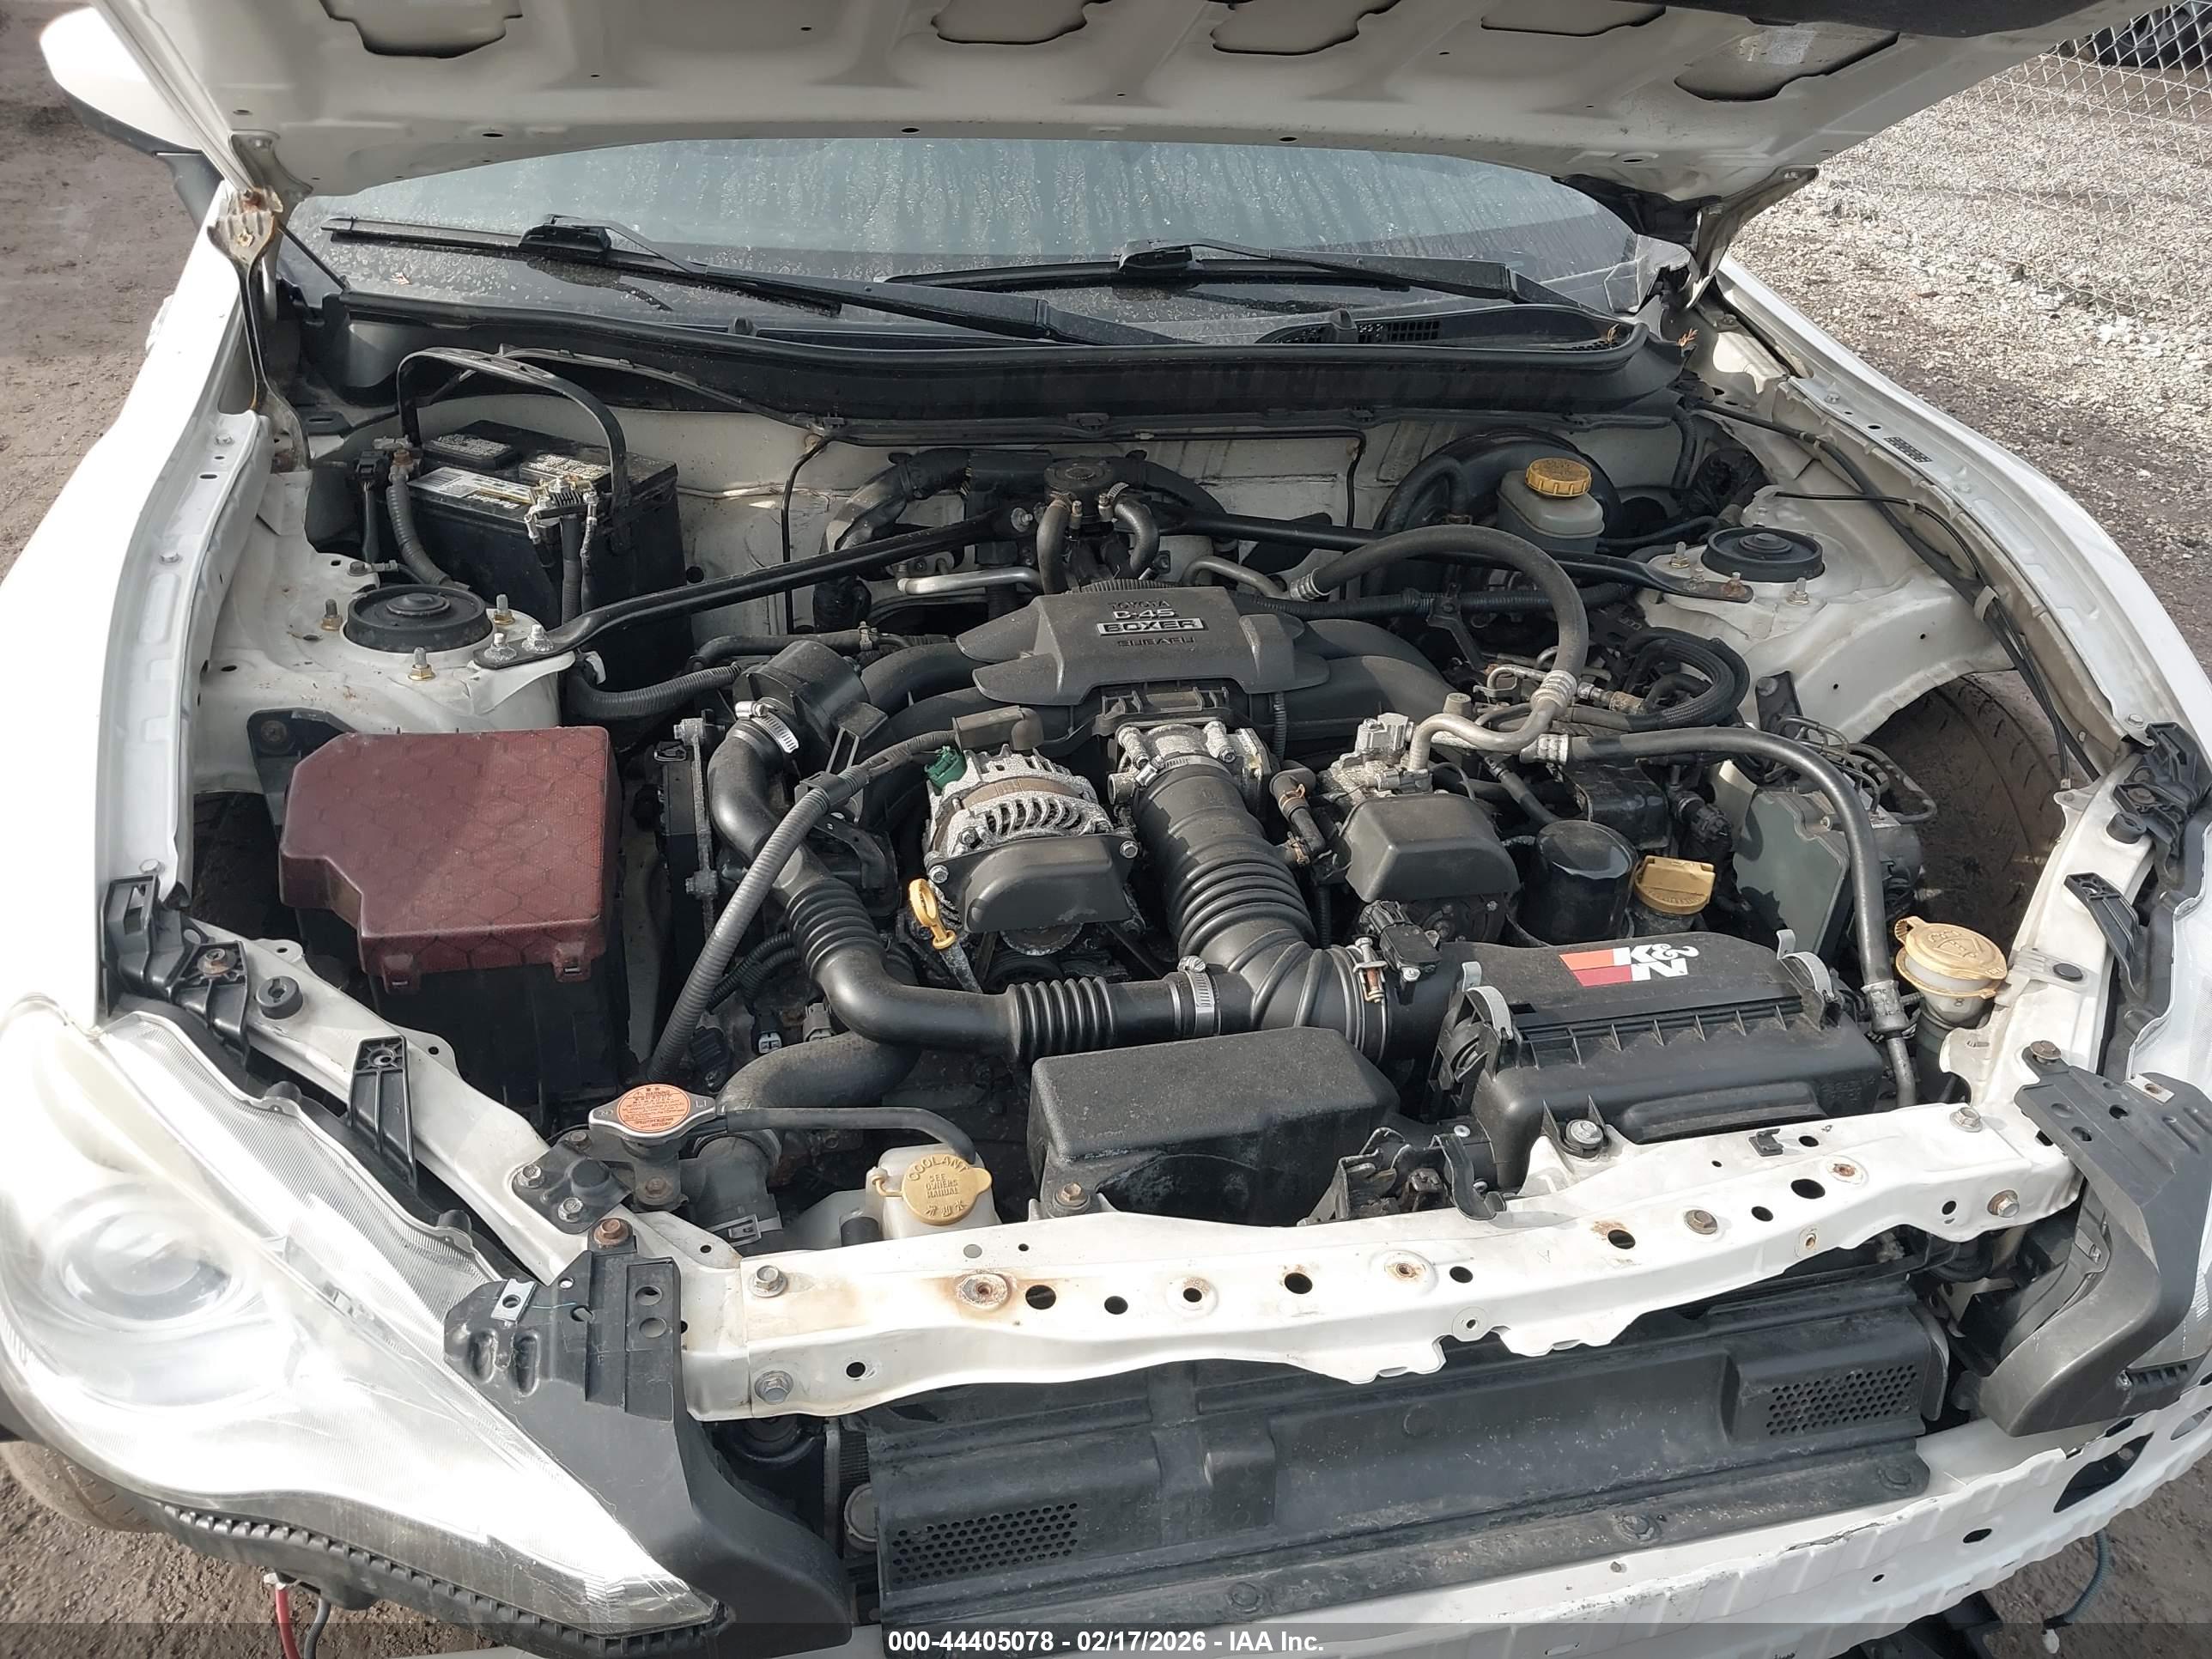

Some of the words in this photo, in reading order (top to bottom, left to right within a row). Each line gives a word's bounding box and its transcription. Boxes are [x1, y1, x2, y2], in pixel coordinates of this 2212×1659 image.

[1108, 600, 1170, 611] TOYOTA
[1103, 620, 1197, 633] BOXER
[1117, 636, 1196, 647] SUBARU
[1613, 943, 1699, 981] K&N
[907, 1156, 969, 1182] COOLANT
[929, 1173, 945, 1182] SEE
[926, 1179, 958, 1191] OWNERS
[927, 1187, 960, 1199] MANUAL
